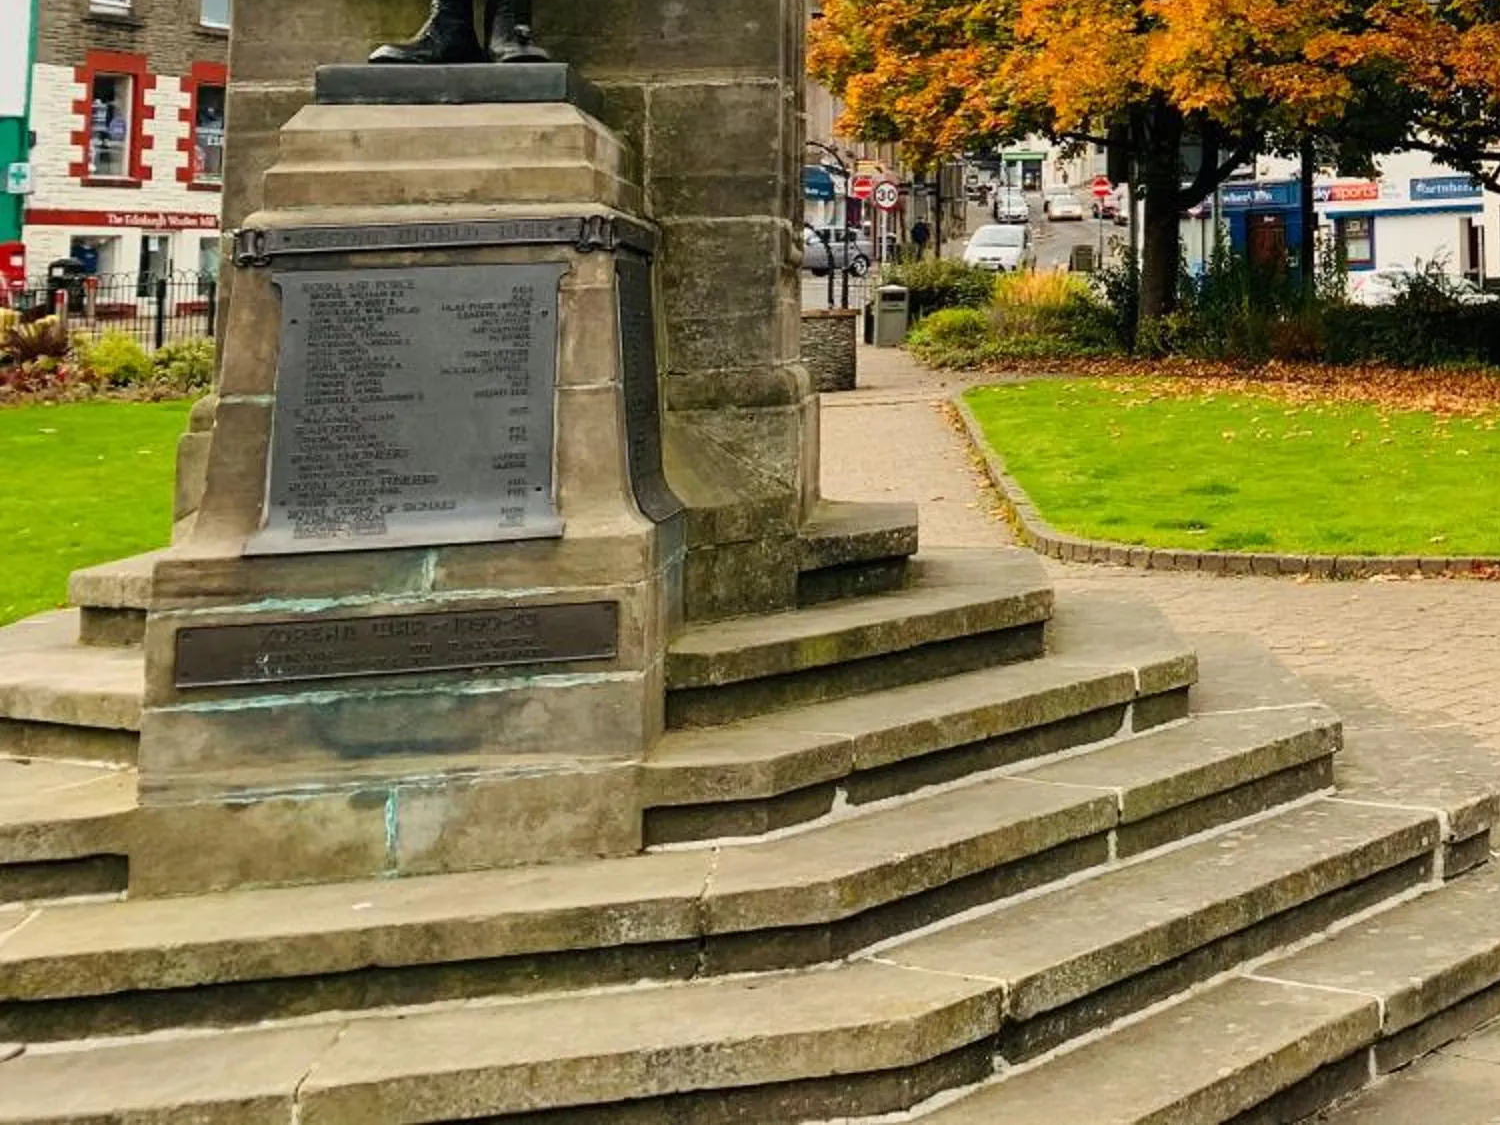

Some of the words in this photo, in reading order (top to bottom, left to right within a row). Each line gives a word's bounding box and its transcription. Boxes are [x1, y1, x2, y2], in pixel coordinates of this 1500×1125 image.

[878, 188, 896, 202] 30
[1333, 183, 1377, 200] sports
[108, 214, 122, 225] The
[125, 214, 163, 229] Edinburgh
[167, 216, 198, 227] Woollen
[200, 216, 216, 227] Mill
